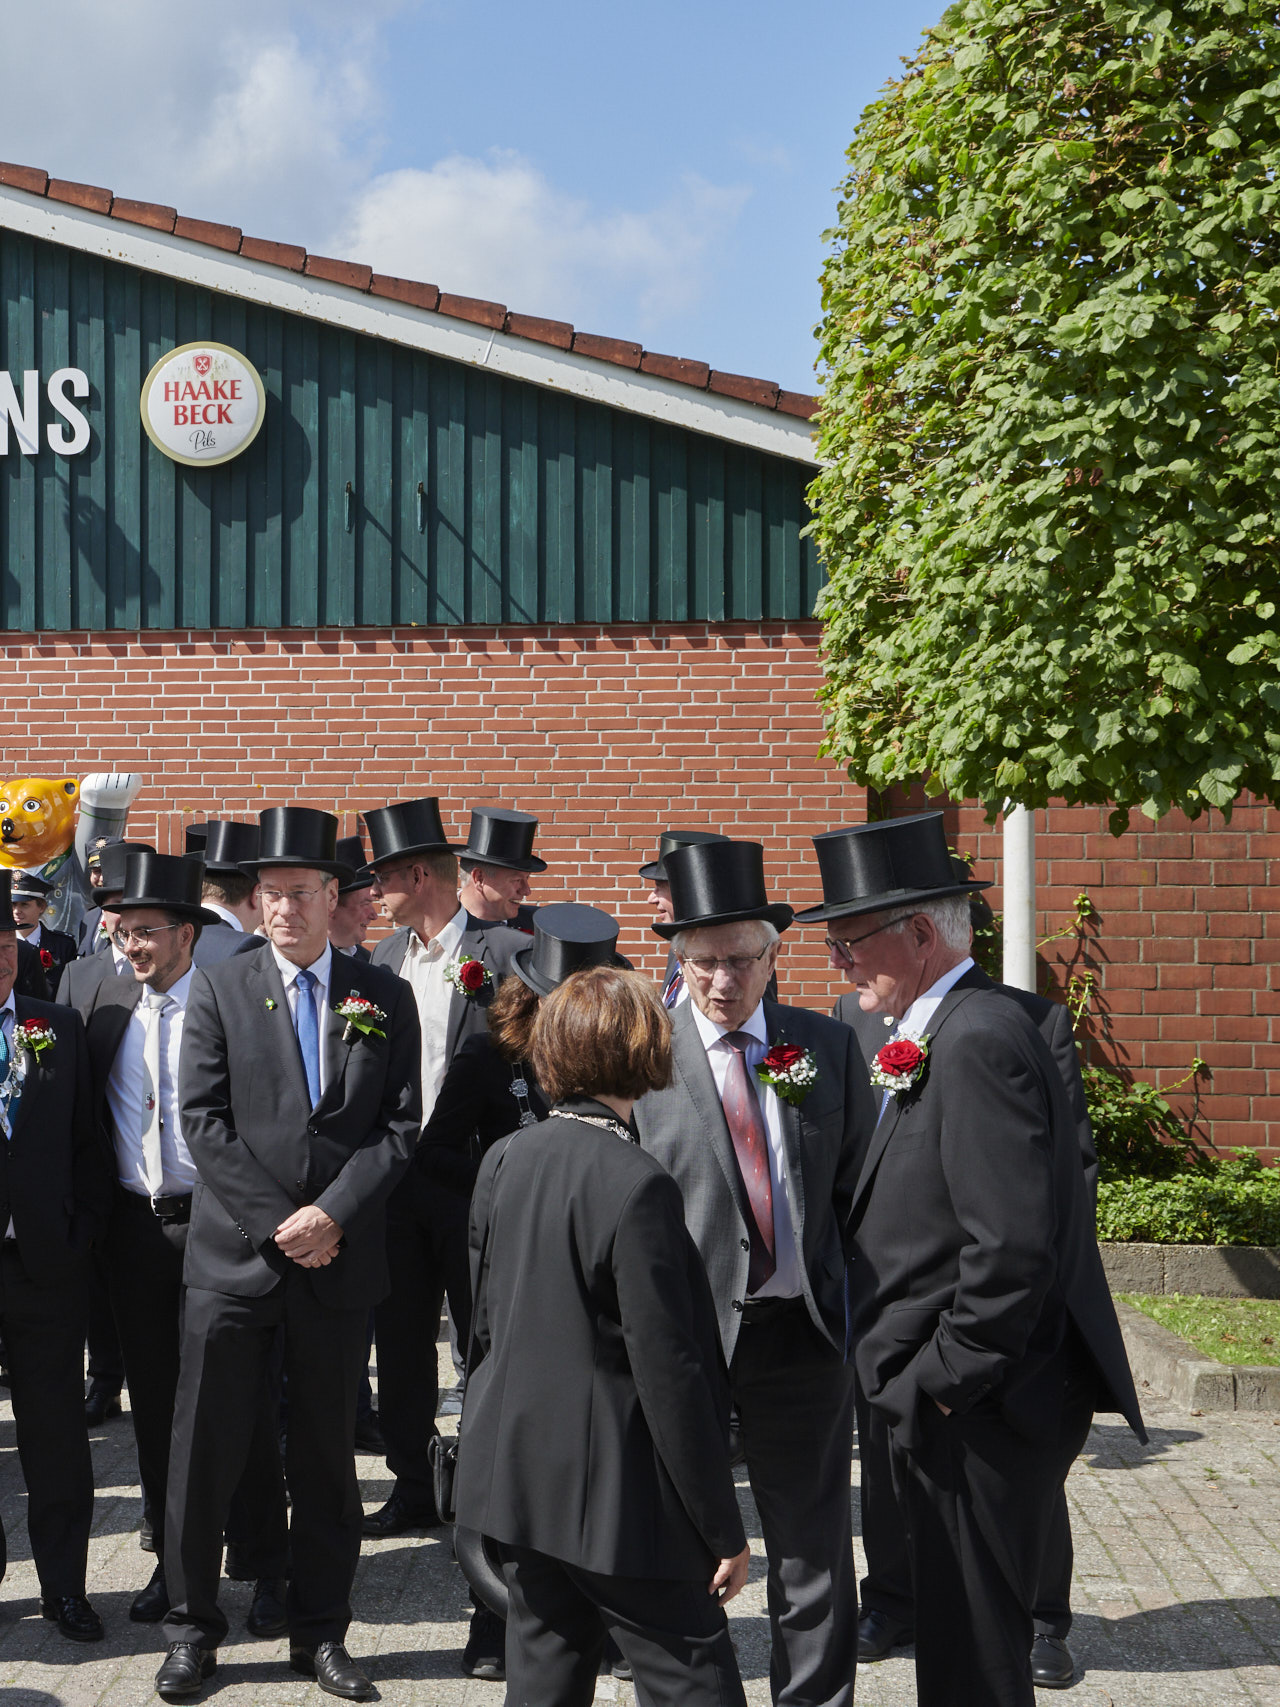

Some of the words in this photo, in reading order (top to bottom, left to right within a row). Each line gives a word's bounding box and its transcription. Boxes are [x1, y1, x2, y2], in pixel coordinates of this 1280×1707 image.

[163, 379, 243, 402] HAAKE
[174, 403, 234, 426] BECK
[189, 430, 217, 451] Pils
